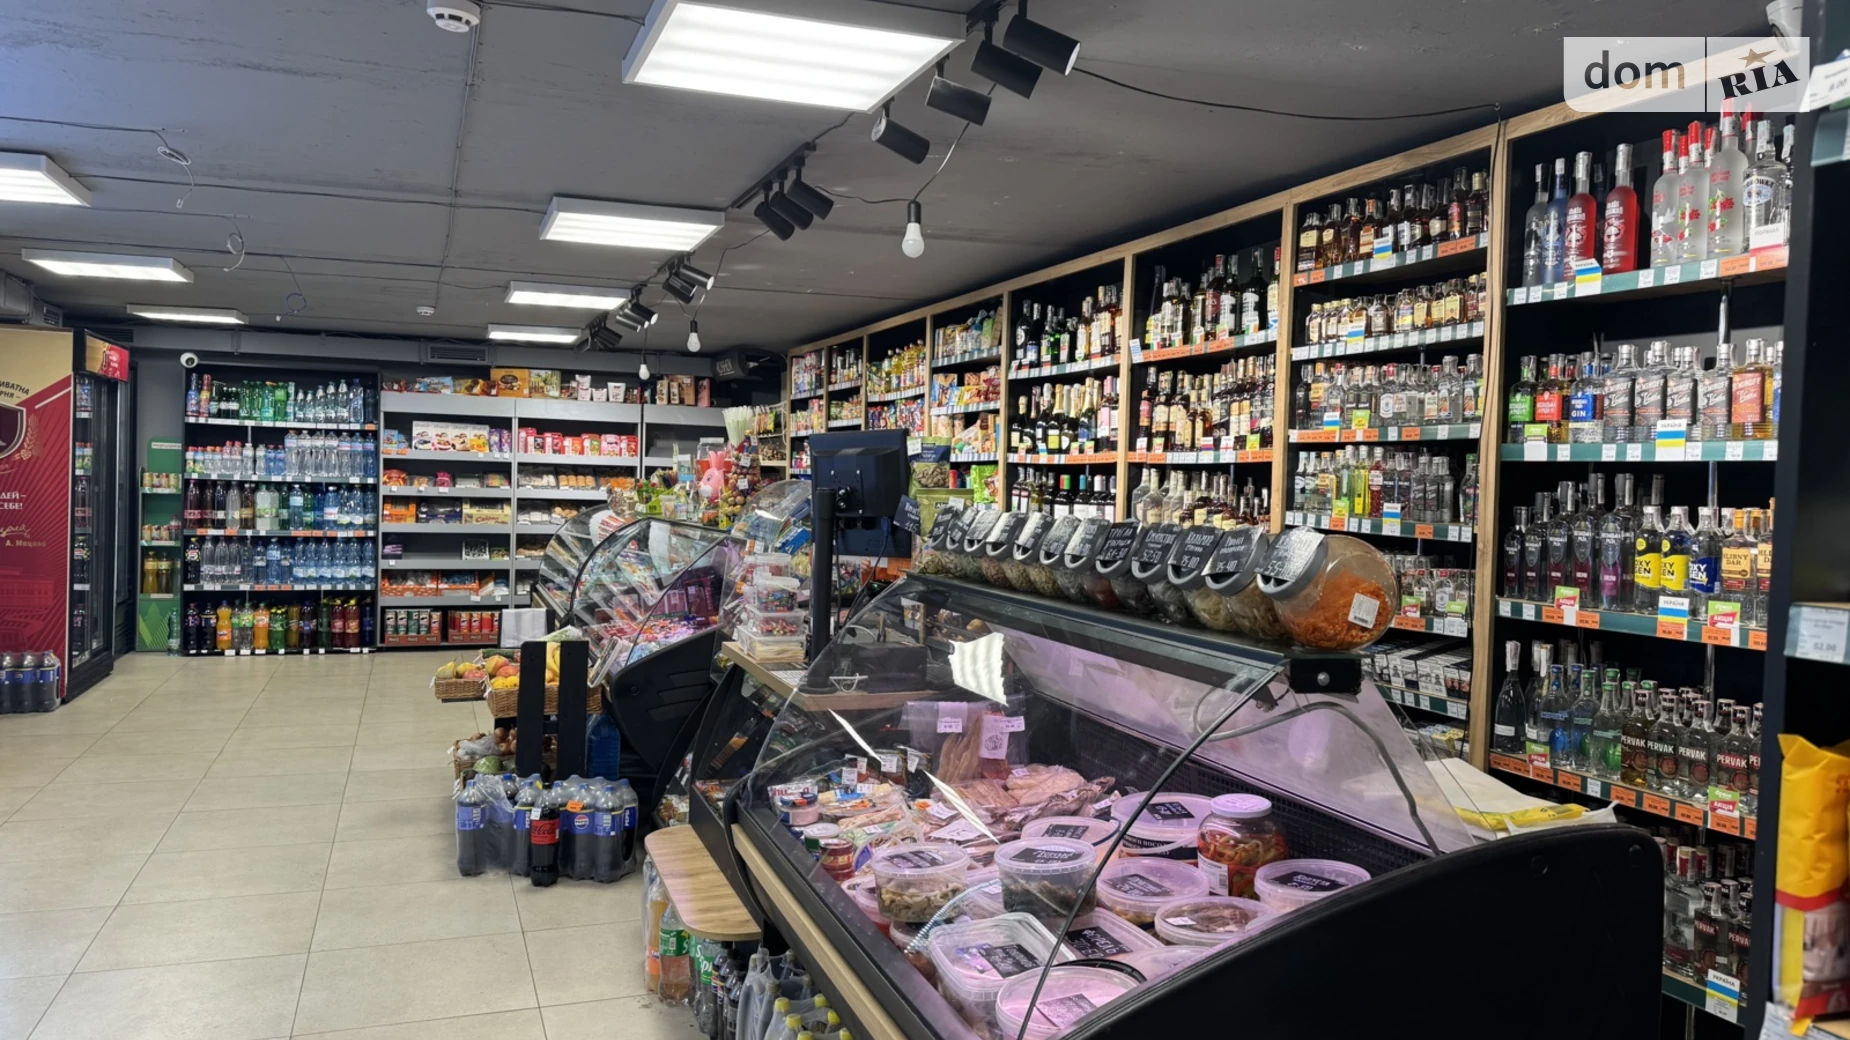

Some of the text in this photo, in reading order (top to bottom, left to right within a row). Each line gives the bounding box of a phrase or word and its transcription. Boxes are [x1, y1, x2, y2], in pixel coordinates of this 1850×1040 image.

[1621, 735, 1646, 748] PERVAK
[1647, 740, 1675, 754] PERVAK
[1678, 746, 1706, 760] PERVAK
[1717, 754, 1748, 768] PERVAK
[1728, 932, 1749, 946] PERVA
